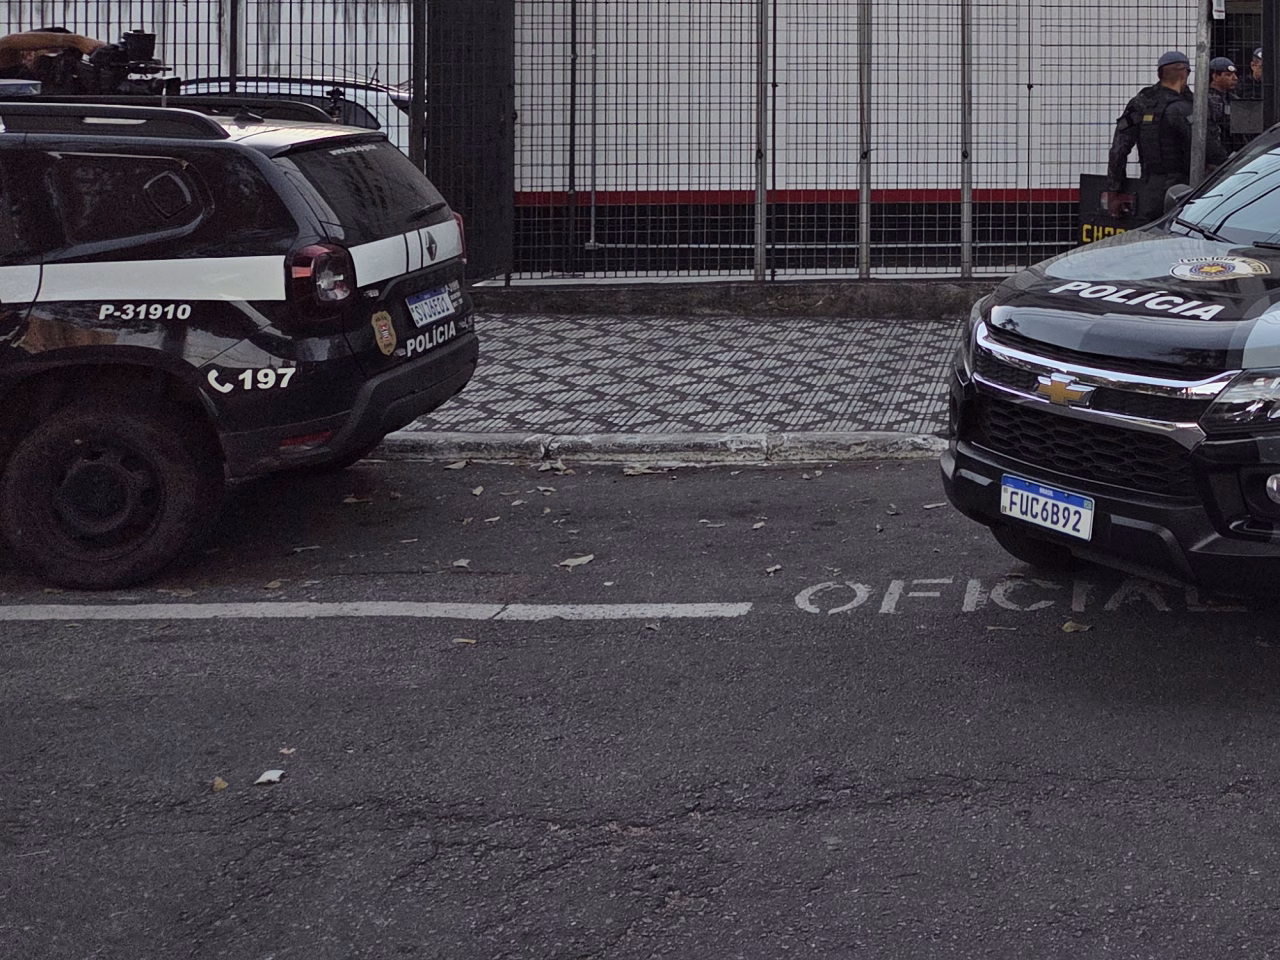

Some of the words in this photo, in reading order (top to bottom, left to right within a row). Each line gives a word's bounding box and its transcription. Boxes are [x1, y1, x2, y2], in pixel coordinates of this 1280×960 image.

[99, 304, 191, 320] P-31910
[1048, 281, 1226, 321] POLÍCIA
[406, 320, 456, 357] POLÍCIA
[238, 368, 296, 390] 197
[1009, 490, 1082, 533] FUC6B92
